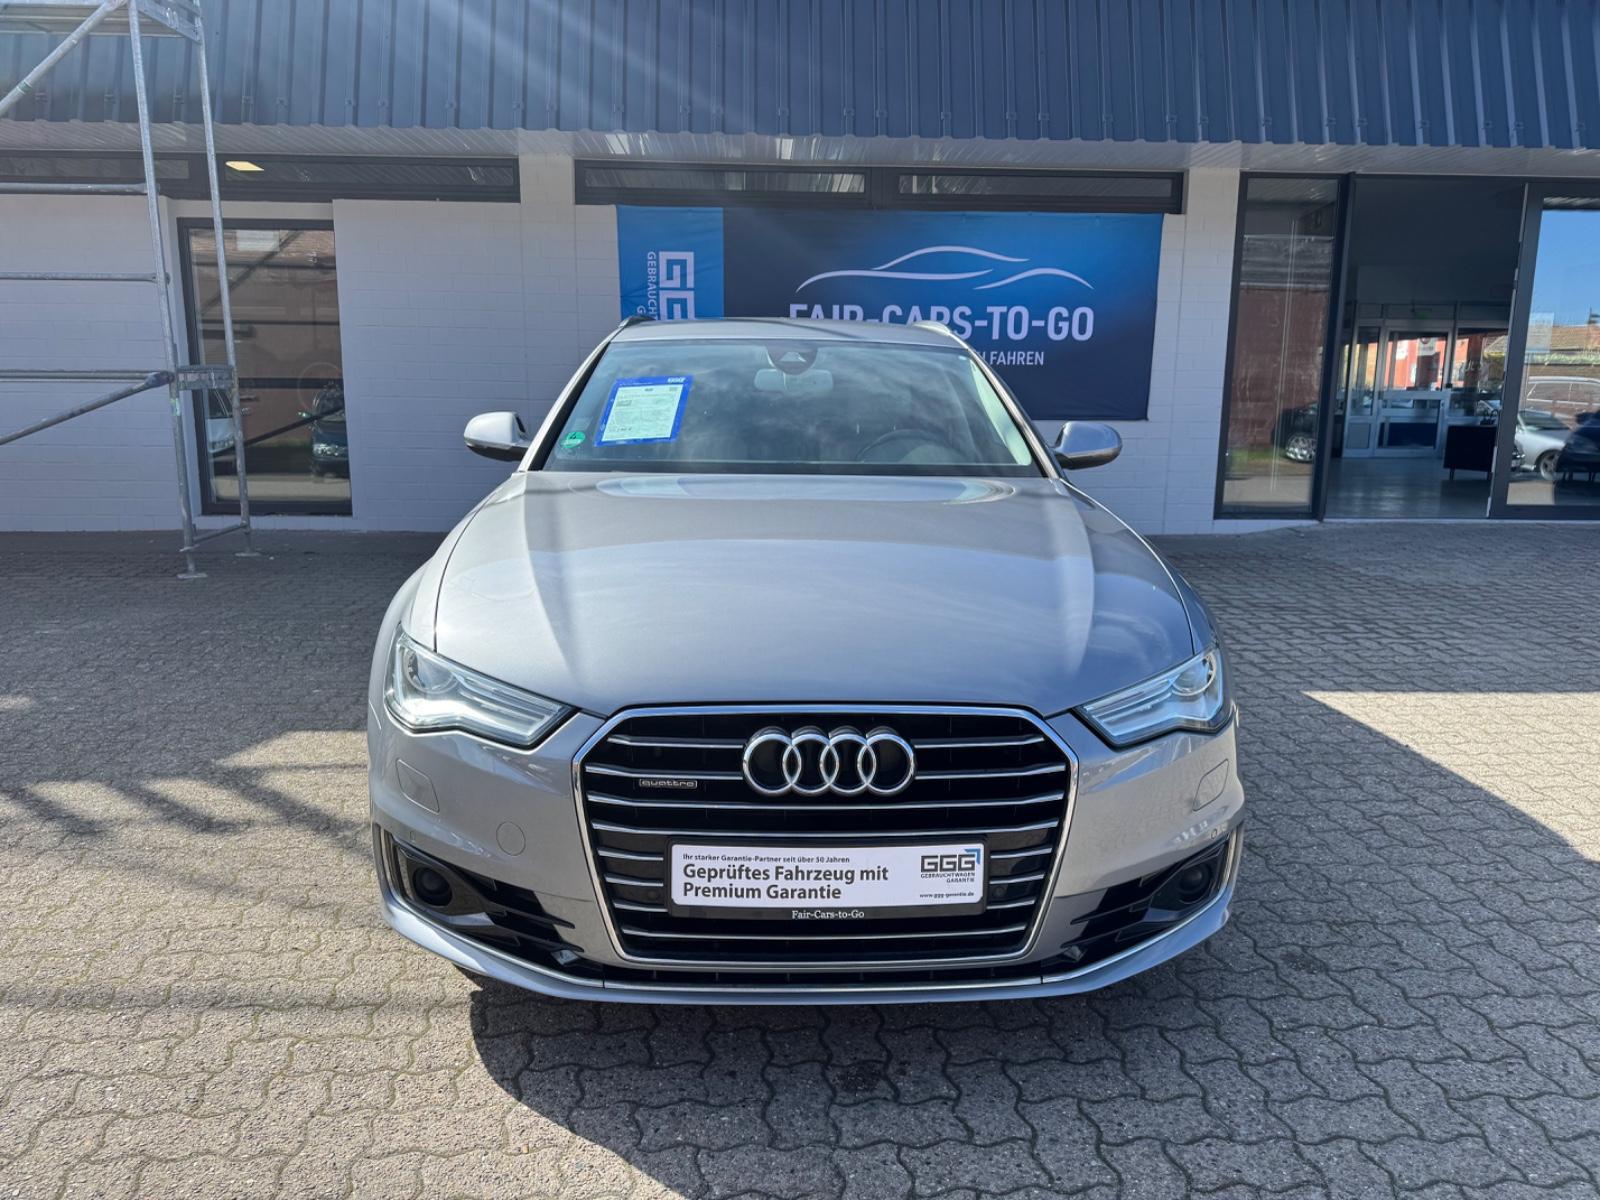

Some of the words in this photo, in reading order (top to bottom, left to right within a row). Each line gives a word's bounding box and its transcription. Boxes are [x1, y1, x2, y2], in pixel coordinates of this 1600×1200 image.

[647, 251, 658, 320] GEBRAUCH
[989, 351, 1044, 366] FAHREN
[641, 780, 695, 788] quattro
[683, 853, 693, 861] Ihr
[721, 855, 781, 863] Garantie-Partner
[921, 854, 976, 873] GGG
[683, 863, 770, 882] Geprüftes
[775, 865, 855, 885] Fahrzeug
[860, 866, 889, 881] mit
[683, 882, 762, 899] Premium
[766, 884, 842, 899] Garantie
[792, 910, 865, 919] Fair-Cars-to-Go
